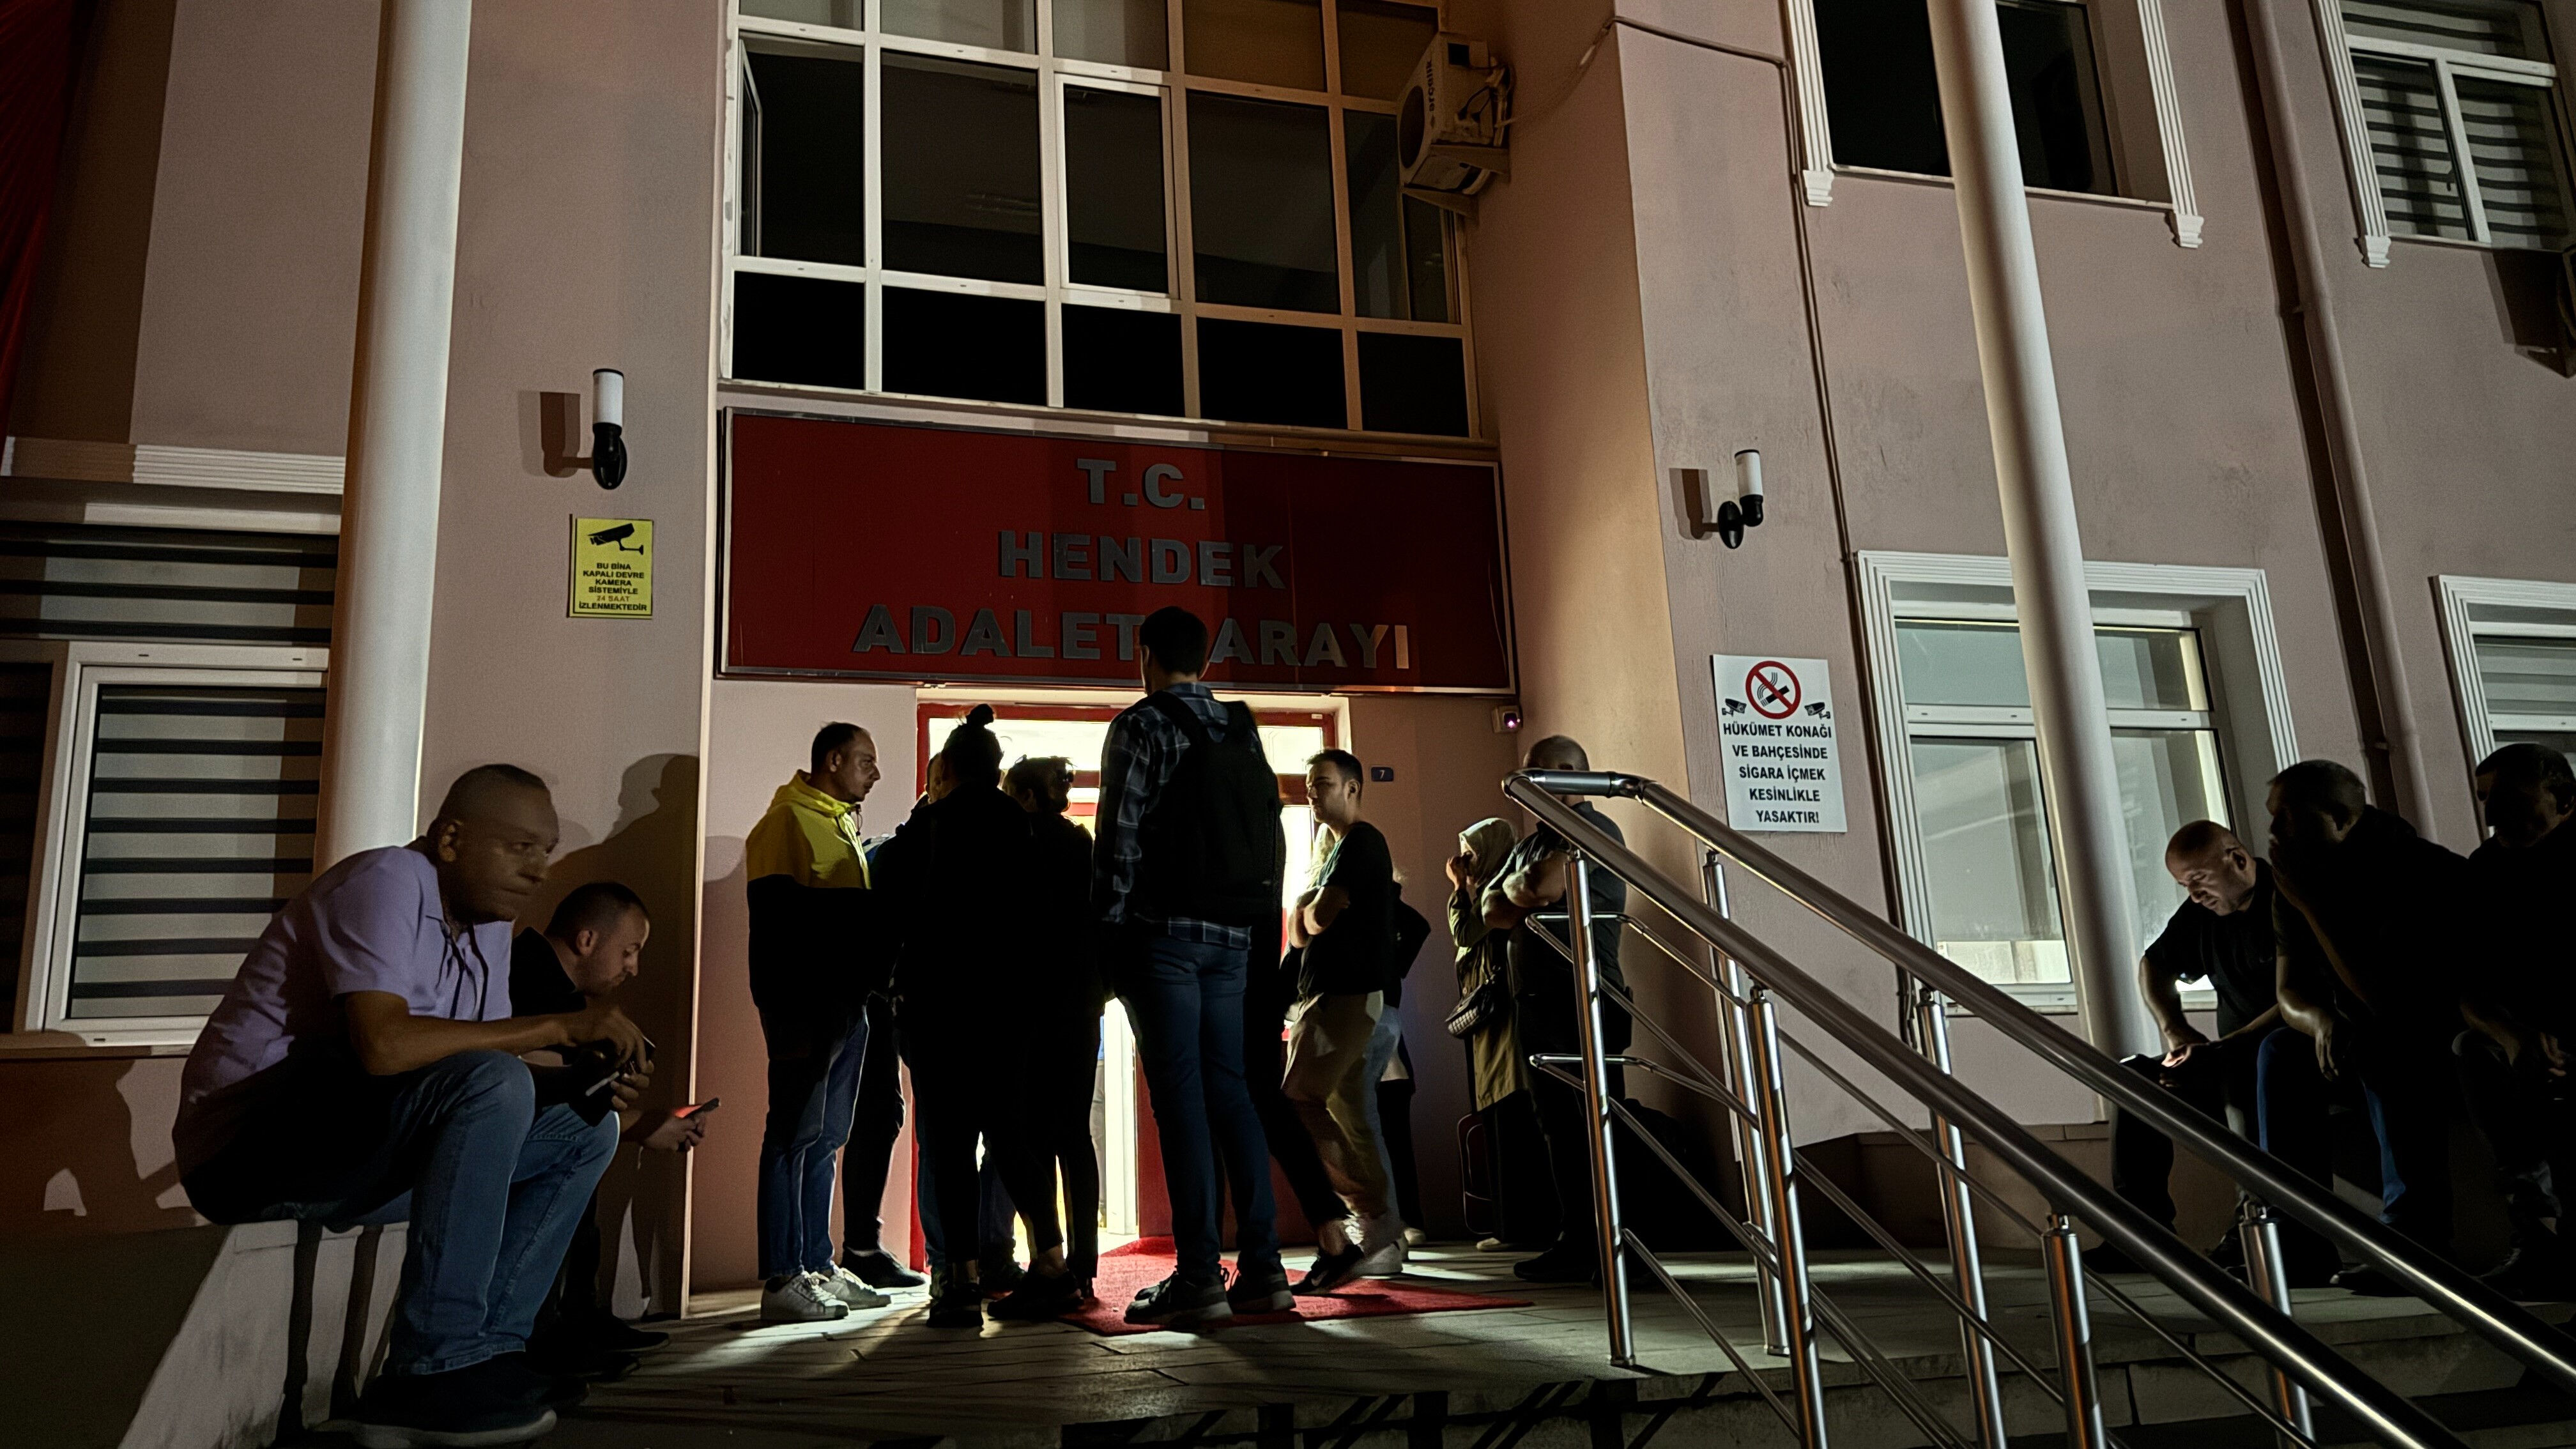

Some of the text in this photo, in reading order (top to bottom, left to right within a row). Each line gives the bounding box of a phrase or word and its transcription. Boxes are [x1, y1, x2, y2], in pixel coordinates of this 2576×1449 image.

[1077, 458, 1205, 510] T.C.
[611, 562, 631, 570] BİNA
[999, 530, 1287, 590] HENDEK
[588, 586, 638, 594] SİSTEMİYLE
[579, 601, 647, 611] İZLENMEKTEDİR
[853, 604, 1409, 670] ADALET ARAYI
[1723, 721, 1832, 739] HÜKÜMET KONAĞI
[1732, 743, 1828, 761] VE BAHÇESİNDE
[1379, 769, 1386, 779] 7
[1739, 763, 1825, 783] SİGARA İÇMEK
[1749, 785, 1820, 802] KESİNLİKLE
[1756, 809, 1820, 824] YASAKTIR!
